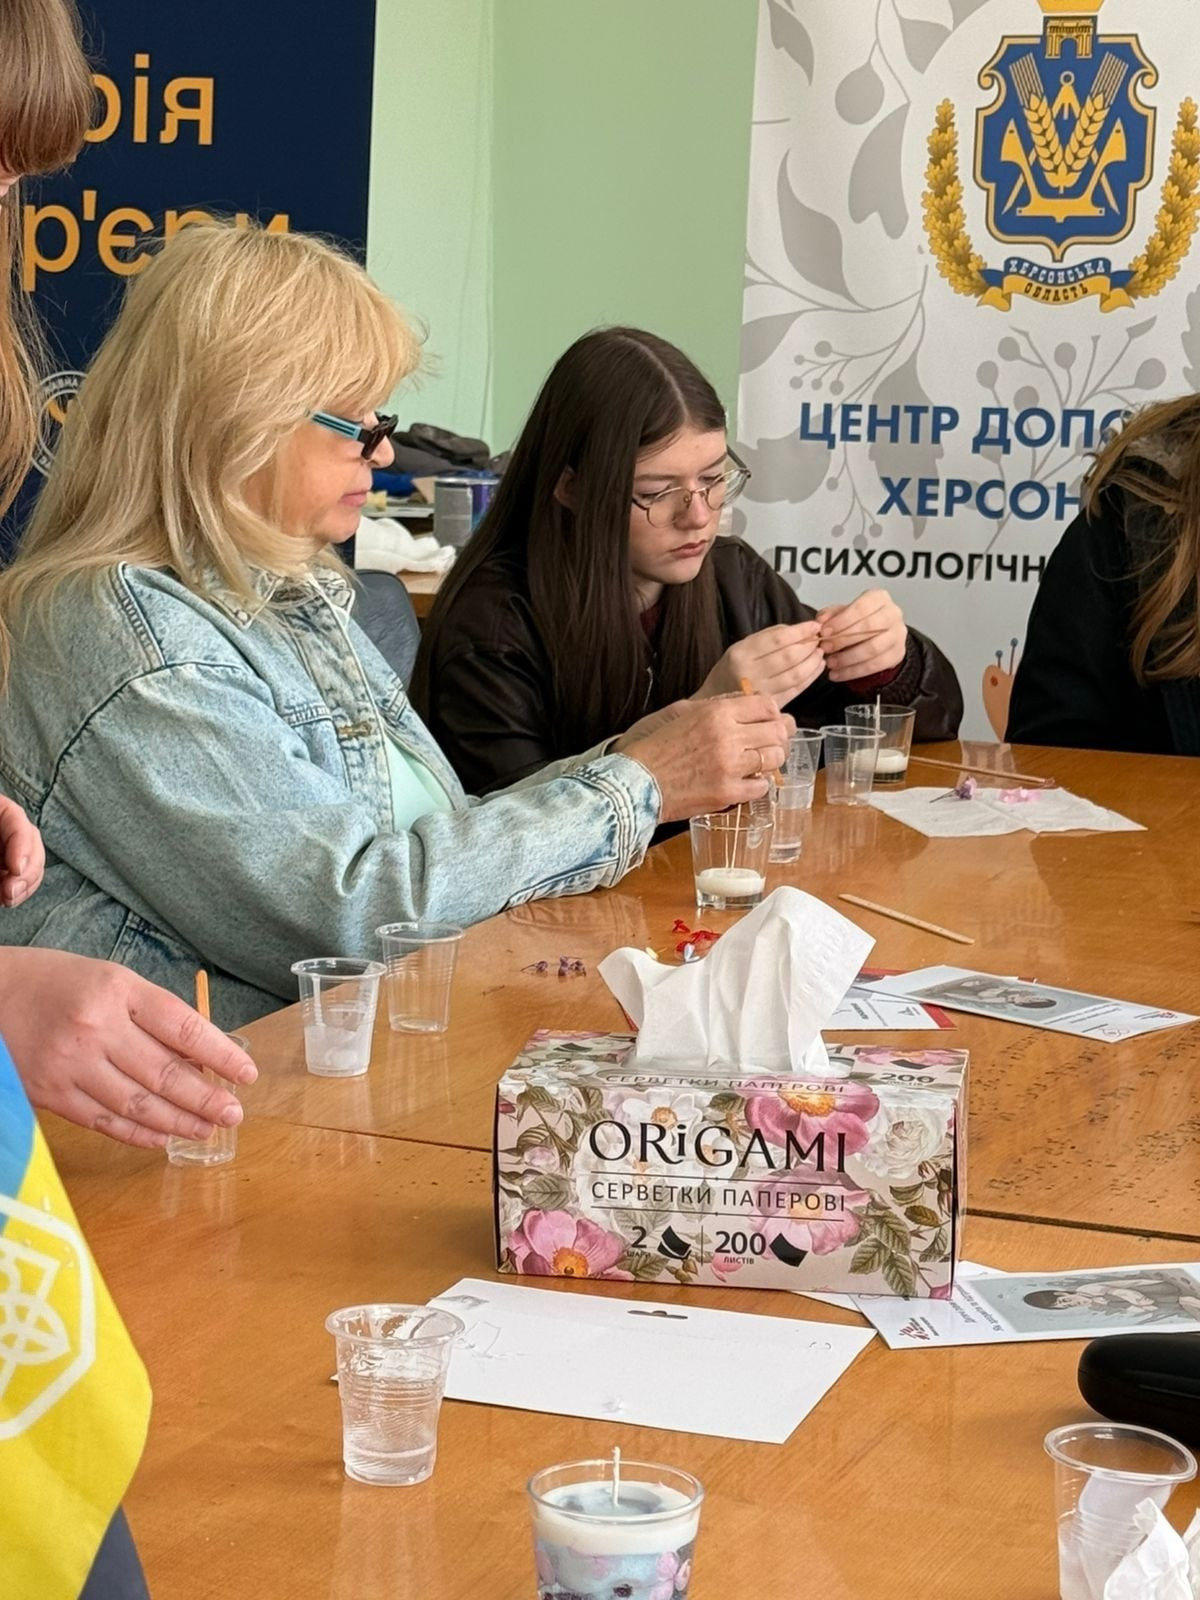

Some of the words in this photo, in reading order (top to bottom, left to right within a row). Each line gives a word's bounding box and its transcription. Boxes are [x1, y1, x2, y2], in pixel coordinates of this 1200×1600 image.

[1008, 260, 1106, 285] ХЕРСОНСЬКА
[1024, 283, 1088, 301] ОБЛАСТЬ
[800, 402, 960, 450] ЦЕНТР
[606, 1075, 718, 1088] СЕРВЕТКИ
[729, 1080, 845, 1093] ПАПЕРОВІ
[880, 1072, 935, 1083] 200
[591, 1181, 712, 1206] СЕРВЕТКИ
[723, 1189, 846, 1212] ПАПЕРОВІ
[631, 1226, 647, 1249] 2
[715, 1231, 766, 1256] 200
